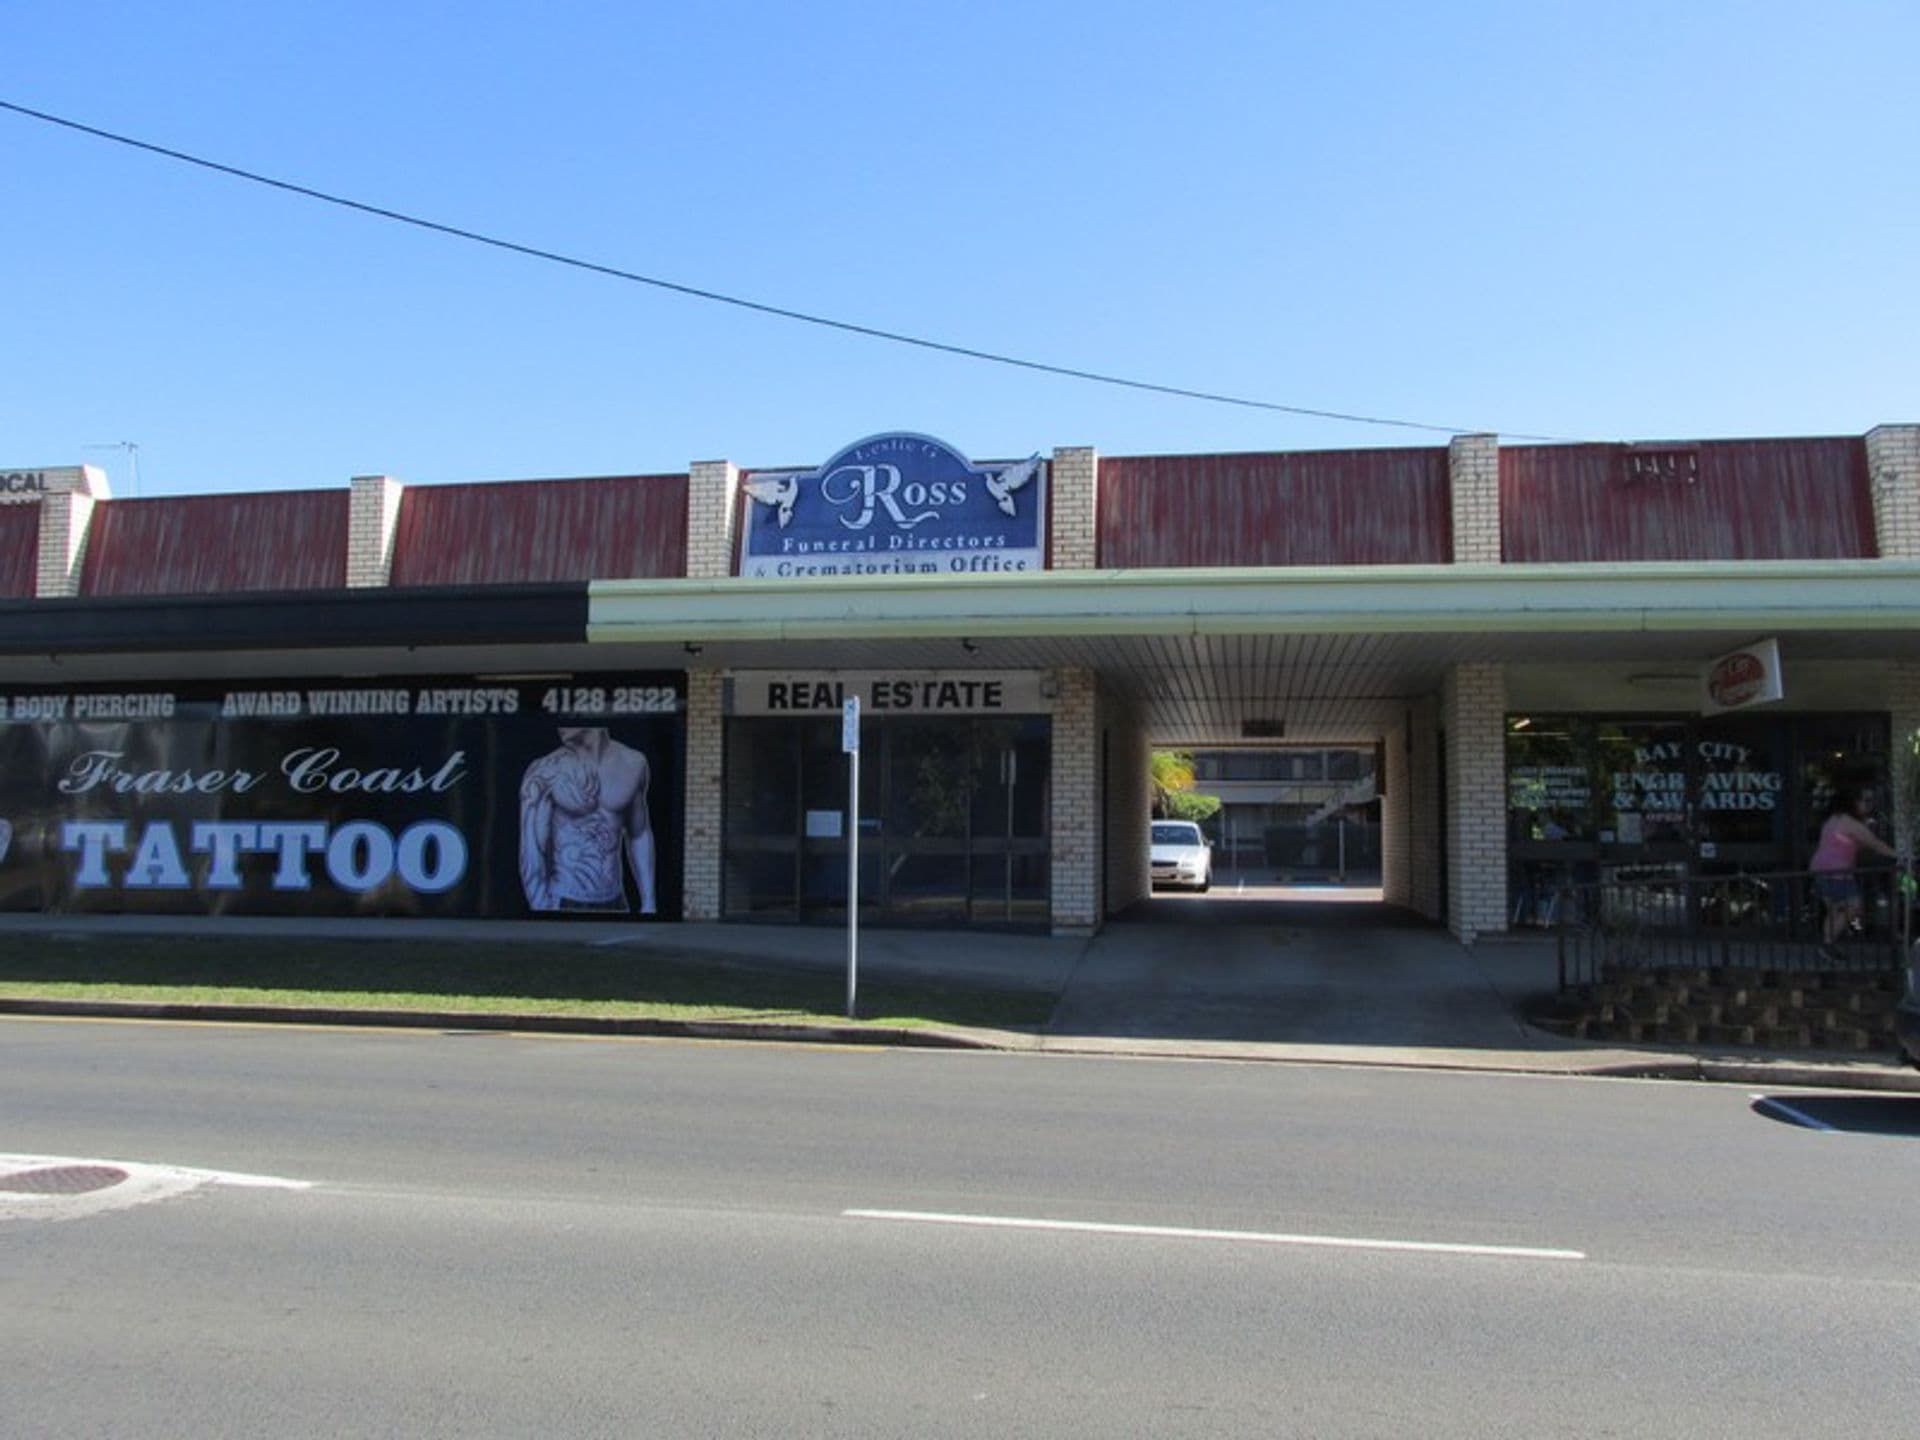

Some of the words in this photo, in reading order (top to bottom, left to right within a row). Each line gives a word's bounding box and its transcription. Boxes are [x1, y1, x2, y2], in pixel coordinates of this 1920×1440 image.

[821, 464, 967, 530] Ross
[783, 536, 875, 552] Funeral
[889, 534, 1006, 550] Directors
[777, 560, 938, 577] Crematorium
[950, 556, 1027, 573] Office
[13, 695, 69, 719] BODY
[73, 693, 175, 718] PIERCING
[221, 692, 301, 717] AWARD
[308, 691, 410, 715] WINNING
[416, 689, 518, 714] ARTISTS
[541, 688, 605, 713] 4128
[612, 688, 677, 713] 2522
[768, 681, 844, 709] REAL
[871, 680, 1002, 708] ESTATE
[1635, 742, 1682, 763] BAY
[1698, 741, 1752, 764] CITY
[57, 749, 267, 795] Fraser
[280, 746, 468, 794] Coast
[61, 819, 468, 894] TATTOO
